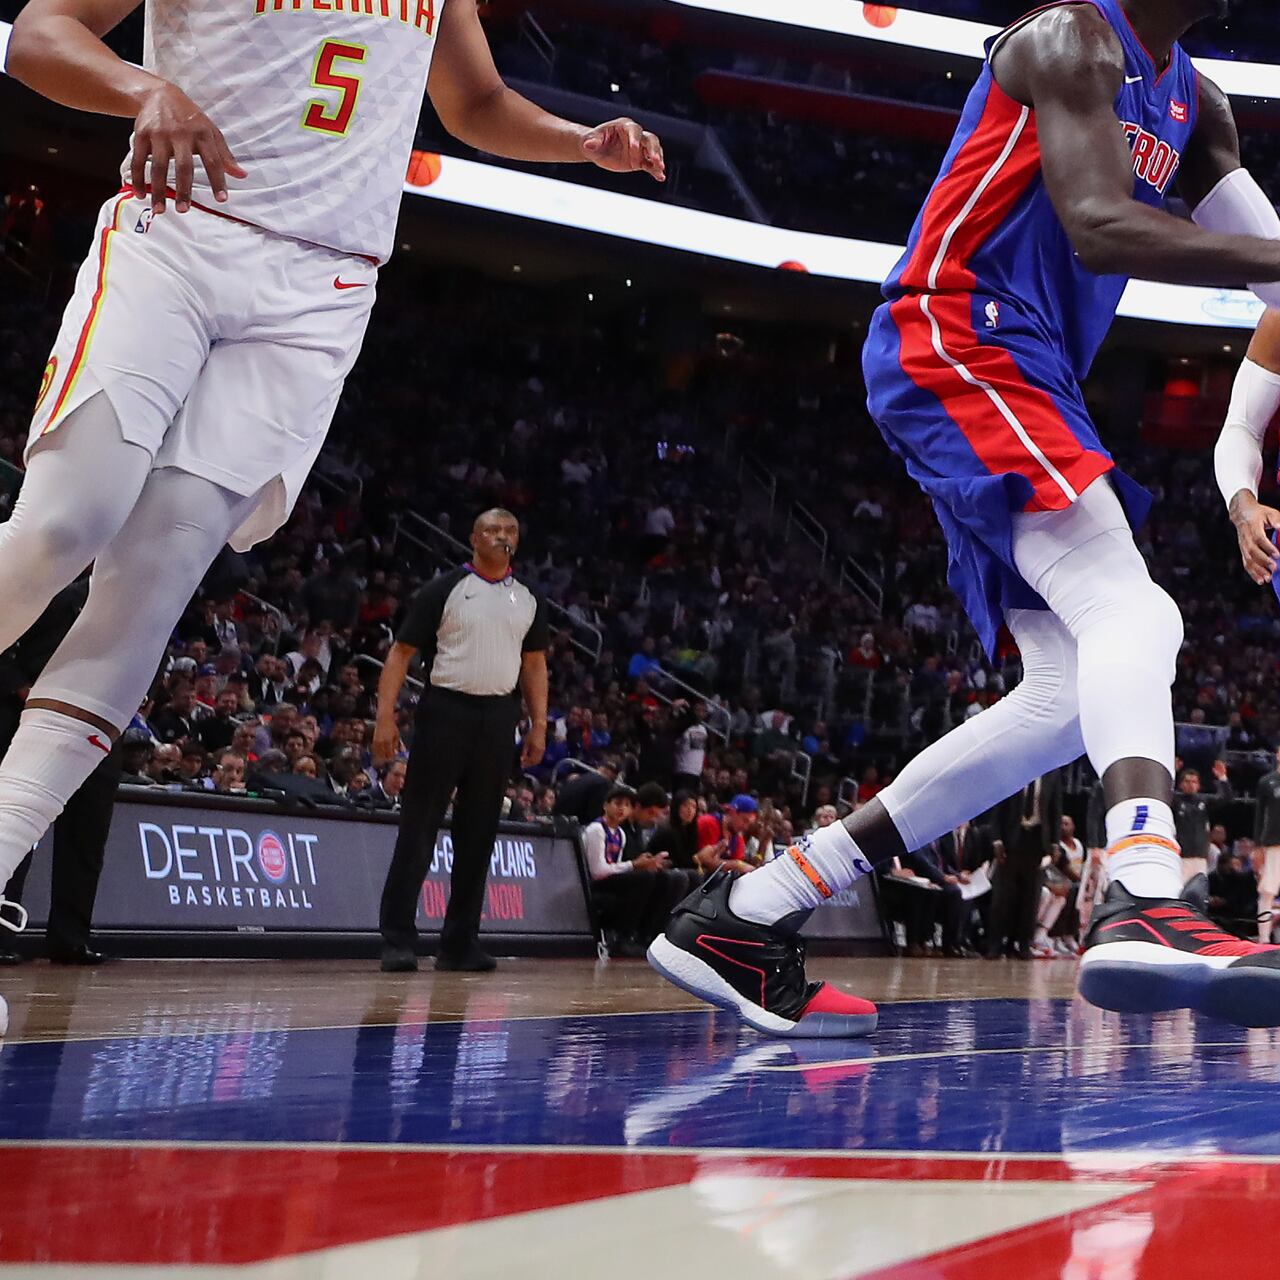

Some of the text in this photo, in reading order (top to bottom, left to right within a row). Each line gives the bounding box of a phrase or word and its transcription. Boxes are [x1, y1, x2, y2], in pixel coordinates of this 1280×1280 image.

[303, 38, 369, 138] 5
[138, 822, 319, 886] DETROIT
[491, 839, 537, 878] PLANS
[168, 884, 313, 909] BASKETBALL
[487, 883, 525, 919] NOW
